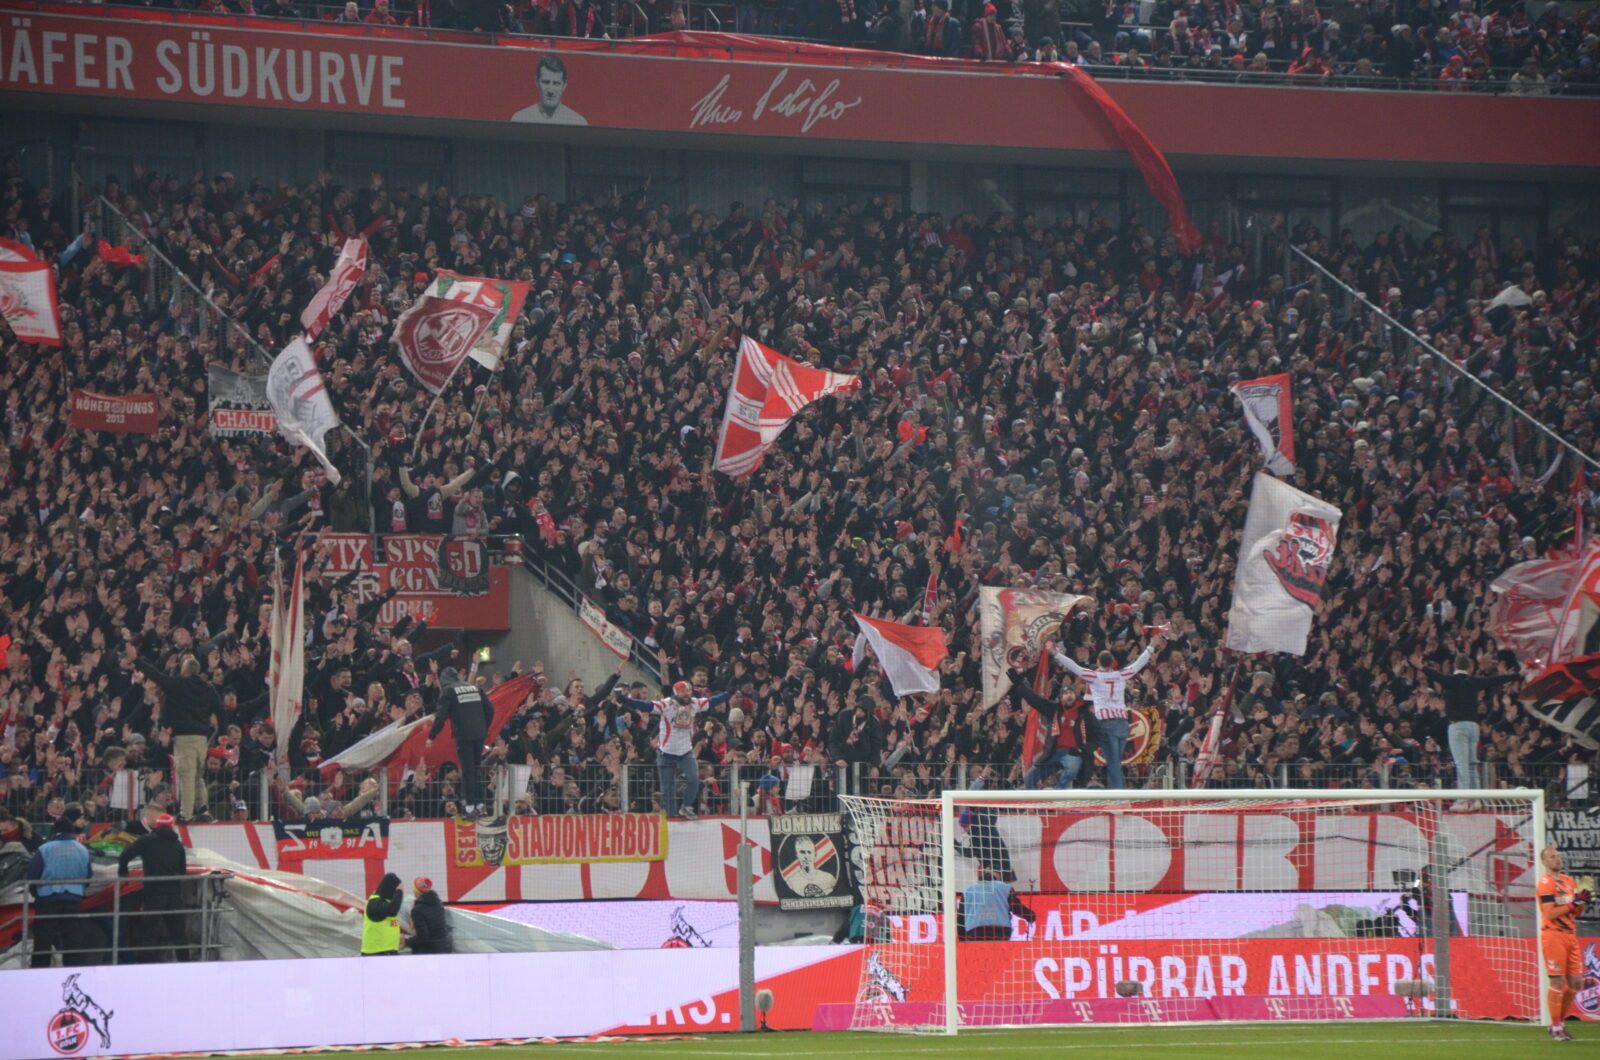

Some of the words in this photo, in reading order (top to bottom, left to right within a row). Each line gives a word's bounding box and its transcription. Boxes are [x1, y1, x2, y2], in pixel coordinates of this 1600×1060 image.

[0, 18, 134, 90] ÄFER
[155, 31, 406, 108] SÜDKURVE
[121, 402, 155, 414] JUNGS
[105, 414, 126, 424] 2013
[1105, 681, 1115, 698] 7
[772, 815, 841, 833] DOMINIK
[459, 824, 476, 863] SEK
[507, 814, 660, 860] STADIONVERBOT
[56, 1023, 80, 1040] 1.FC
